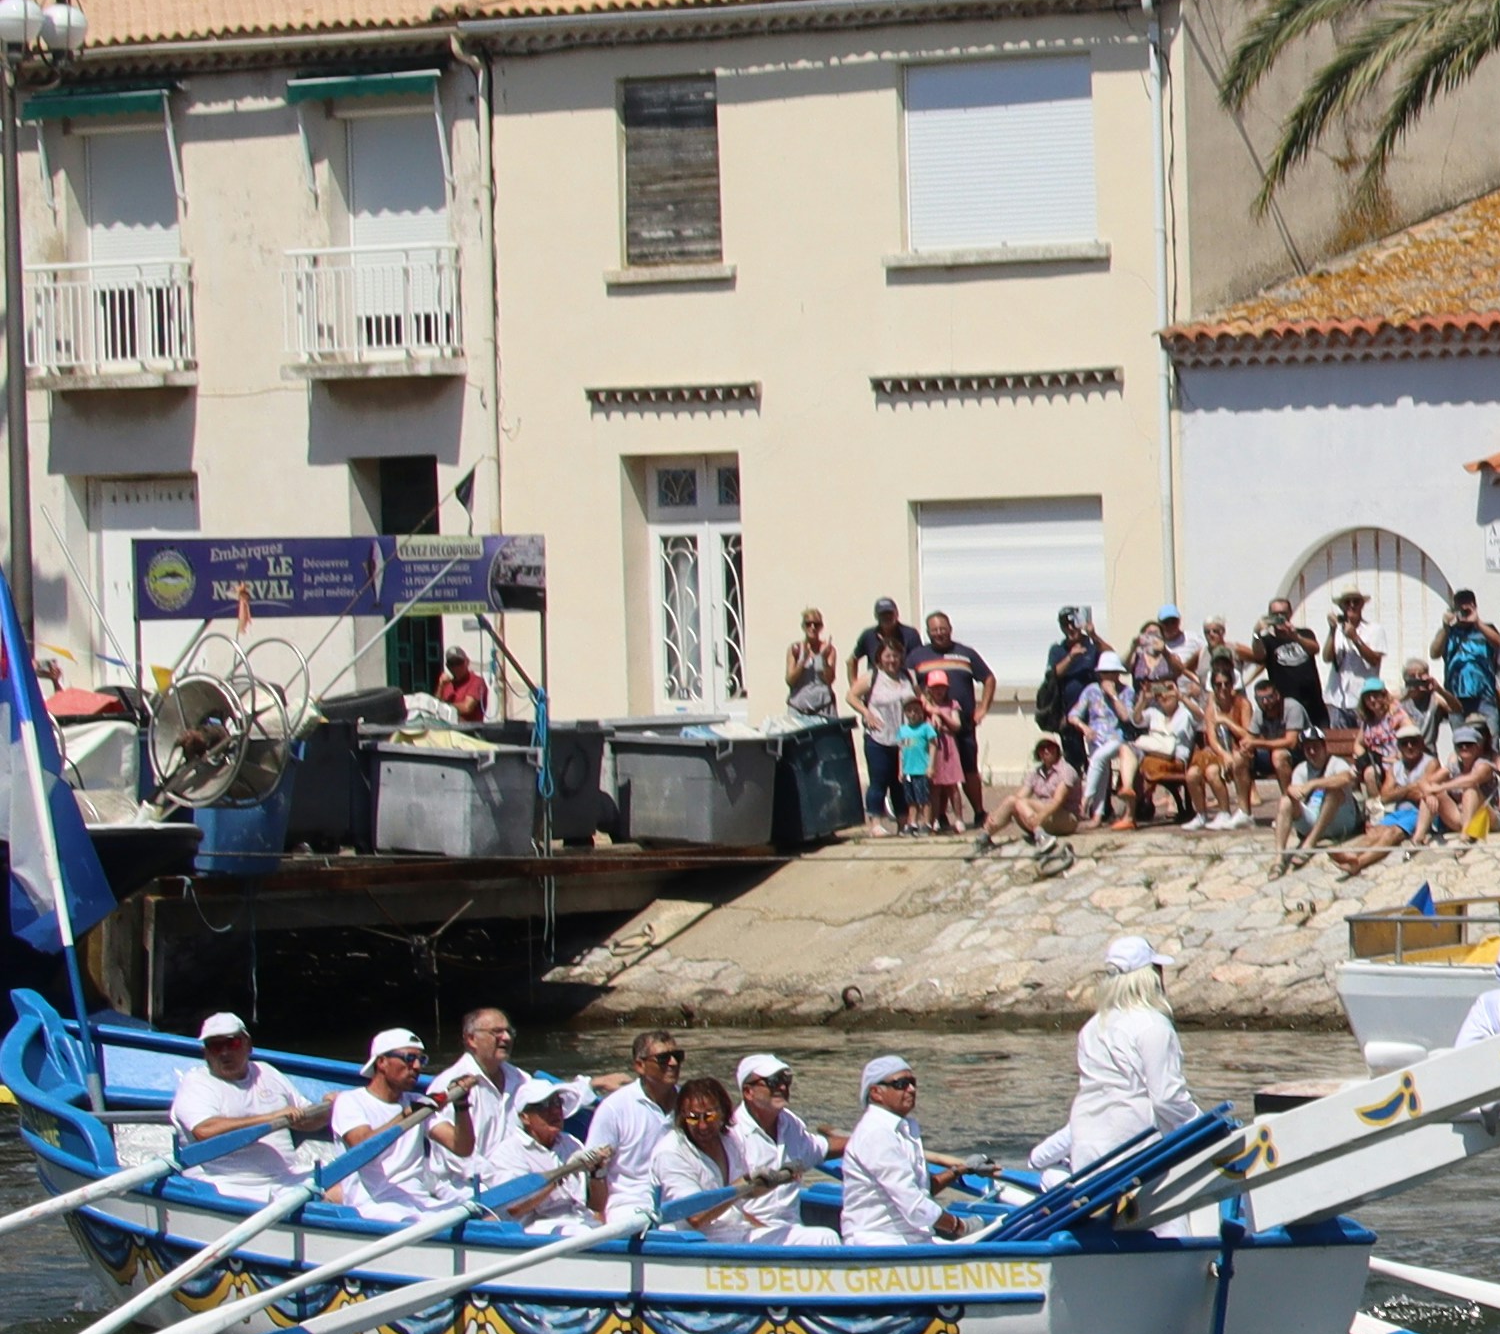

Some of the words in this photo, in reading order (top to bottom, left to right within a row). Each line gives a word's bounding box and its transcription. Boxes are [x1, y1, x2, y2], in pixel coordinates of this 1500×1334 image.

[209, 544, 284, 563] Embarquez
[267, 555, 294, 577] LE
[705, 1265, 749, 1292] LES
[757, 1266, 836, 1293] DEUX
[843, 1262, 1044, 1293] GRAULENNES
